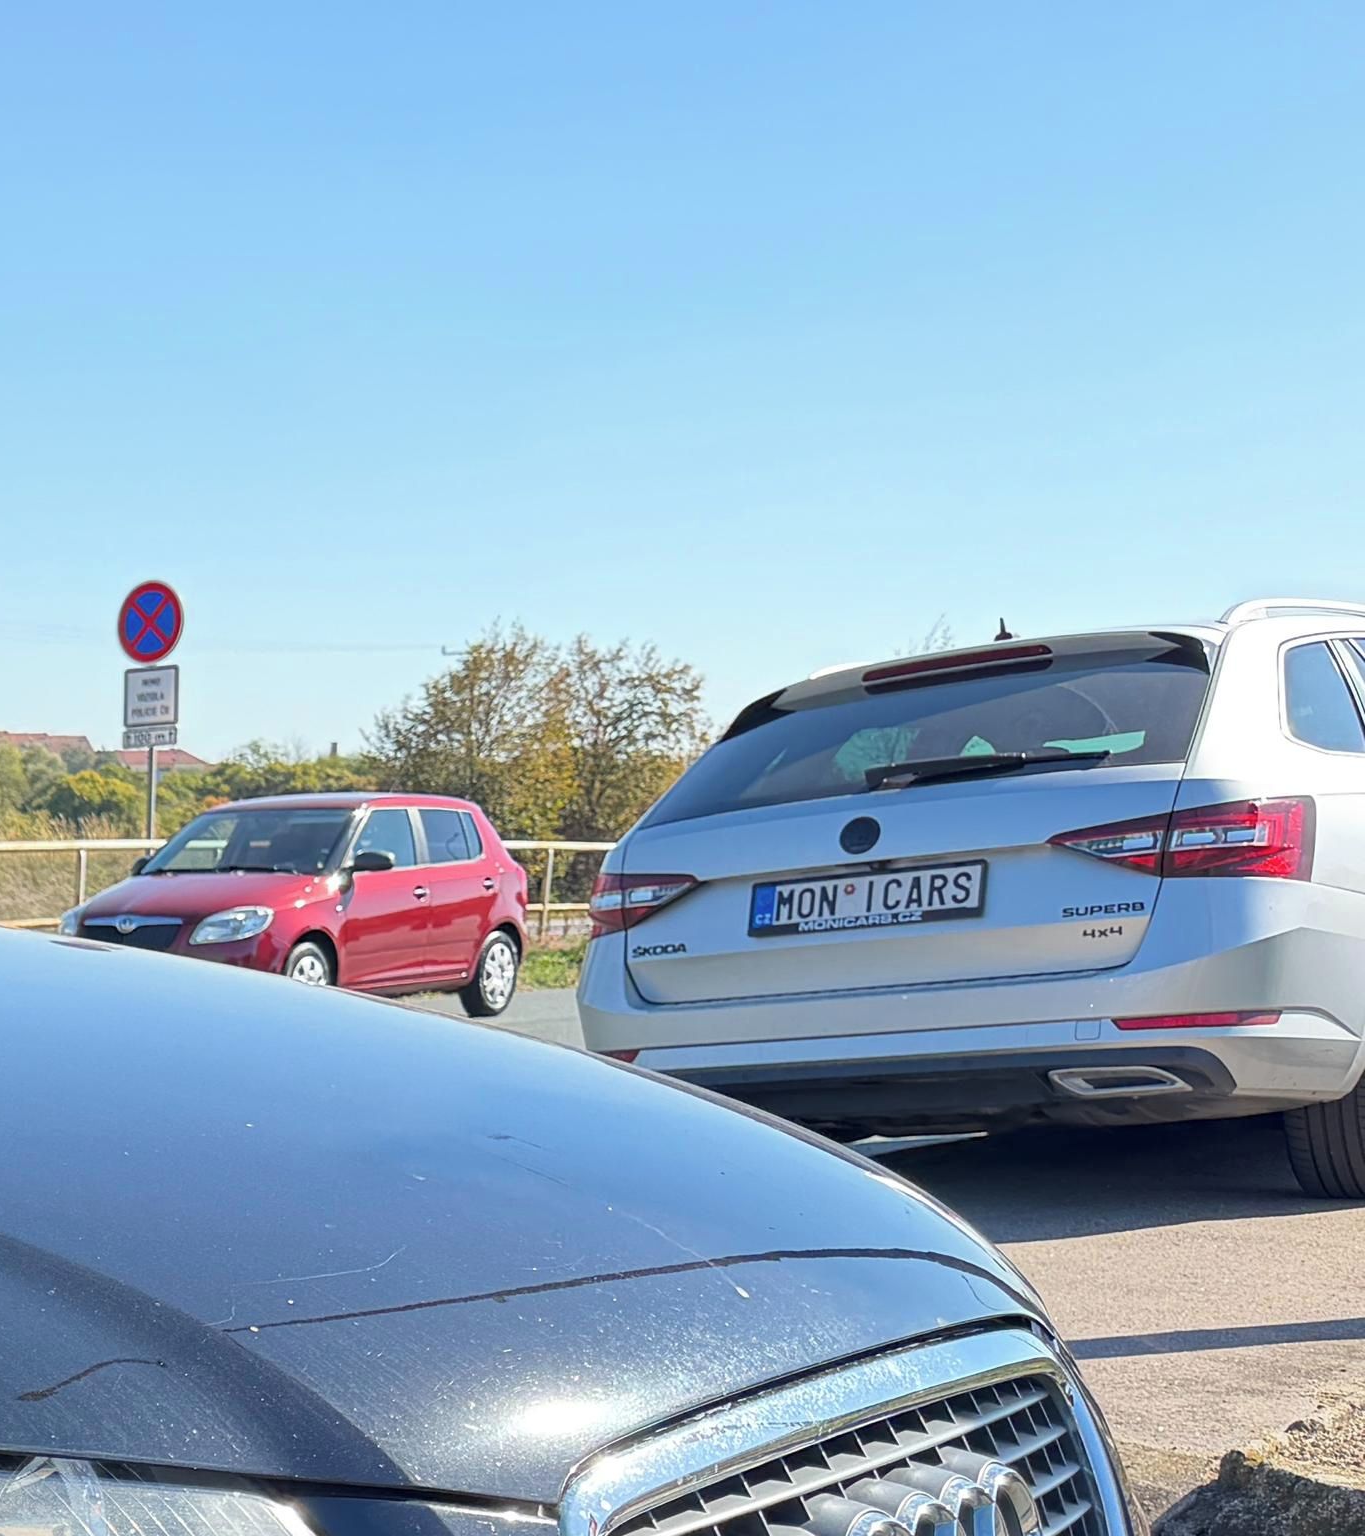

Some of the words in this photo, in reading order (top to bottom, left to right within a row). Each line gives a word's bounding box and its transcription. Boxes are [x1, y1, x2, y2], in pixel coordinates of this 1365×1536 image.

[755, 913, 771, 926] CZ
[775, 883, 839, 922] MON
[866, 871, 973, 913] ICARS
[1062, 901, 1145, 918] SUPERB
[798, 911, 923, 932] MONICARS.CZ
[1082, 925, 1123, 939] 4x4
